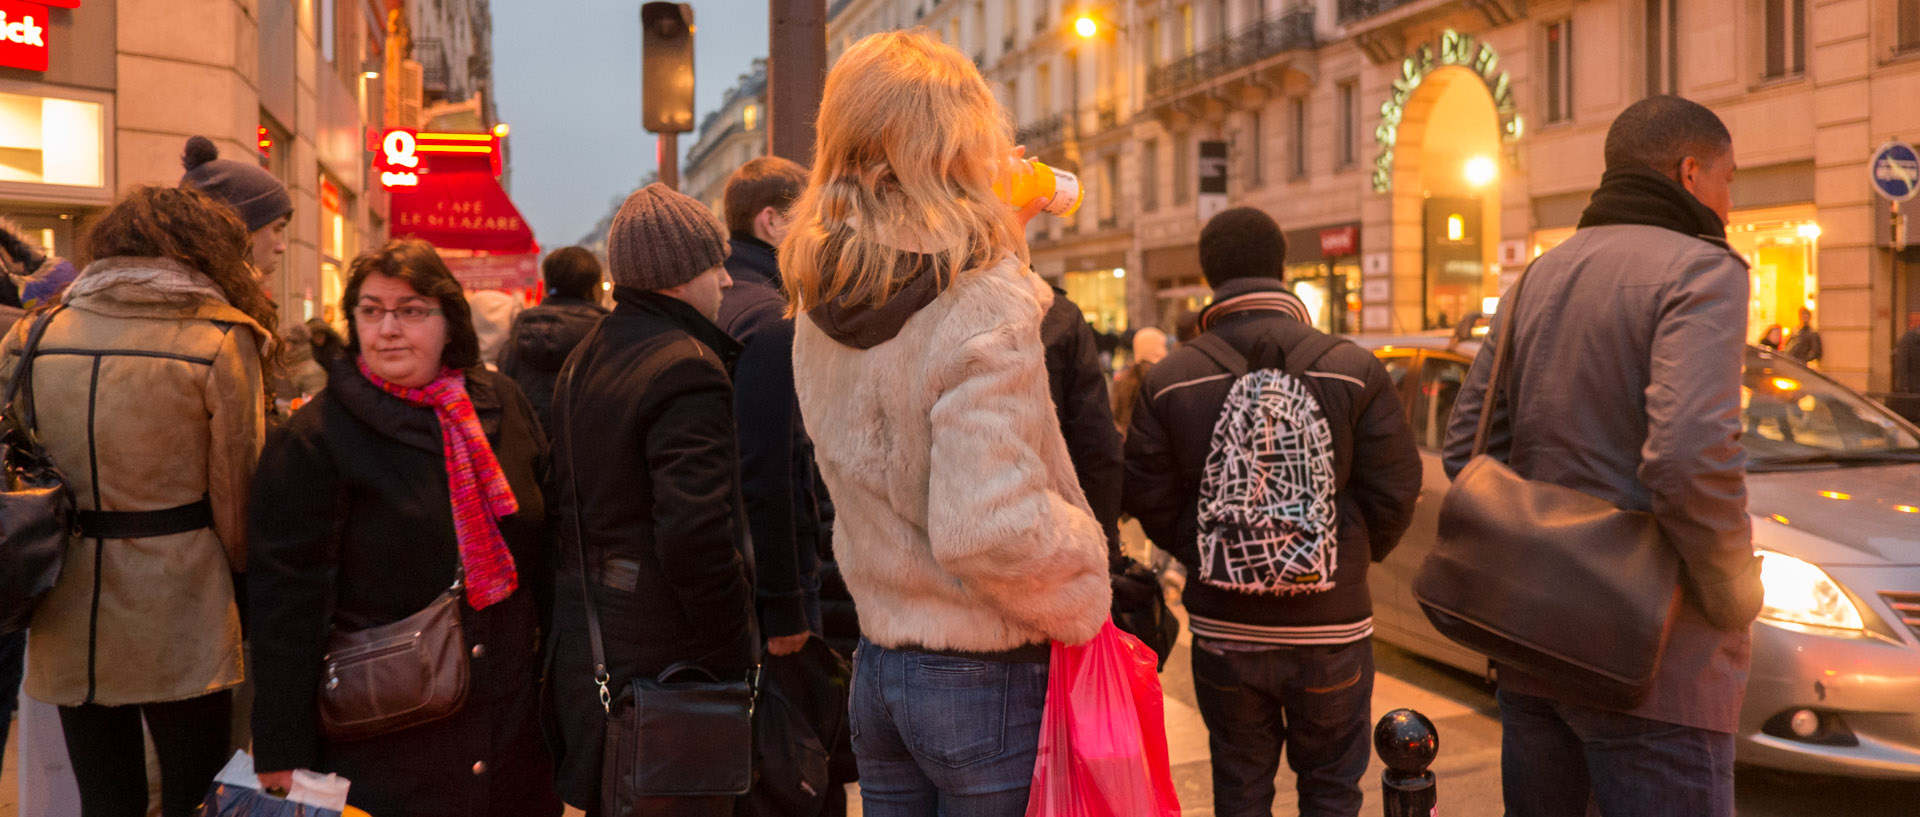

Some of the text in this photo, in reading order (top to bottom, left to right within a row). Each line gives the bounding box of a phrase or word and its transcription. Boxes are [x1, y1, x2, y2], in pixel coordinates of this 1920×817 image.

[383, 130, 419, 168] Q
[401, 212, 421, 225] LE
[449, 216, 519, 231] LAZARE
